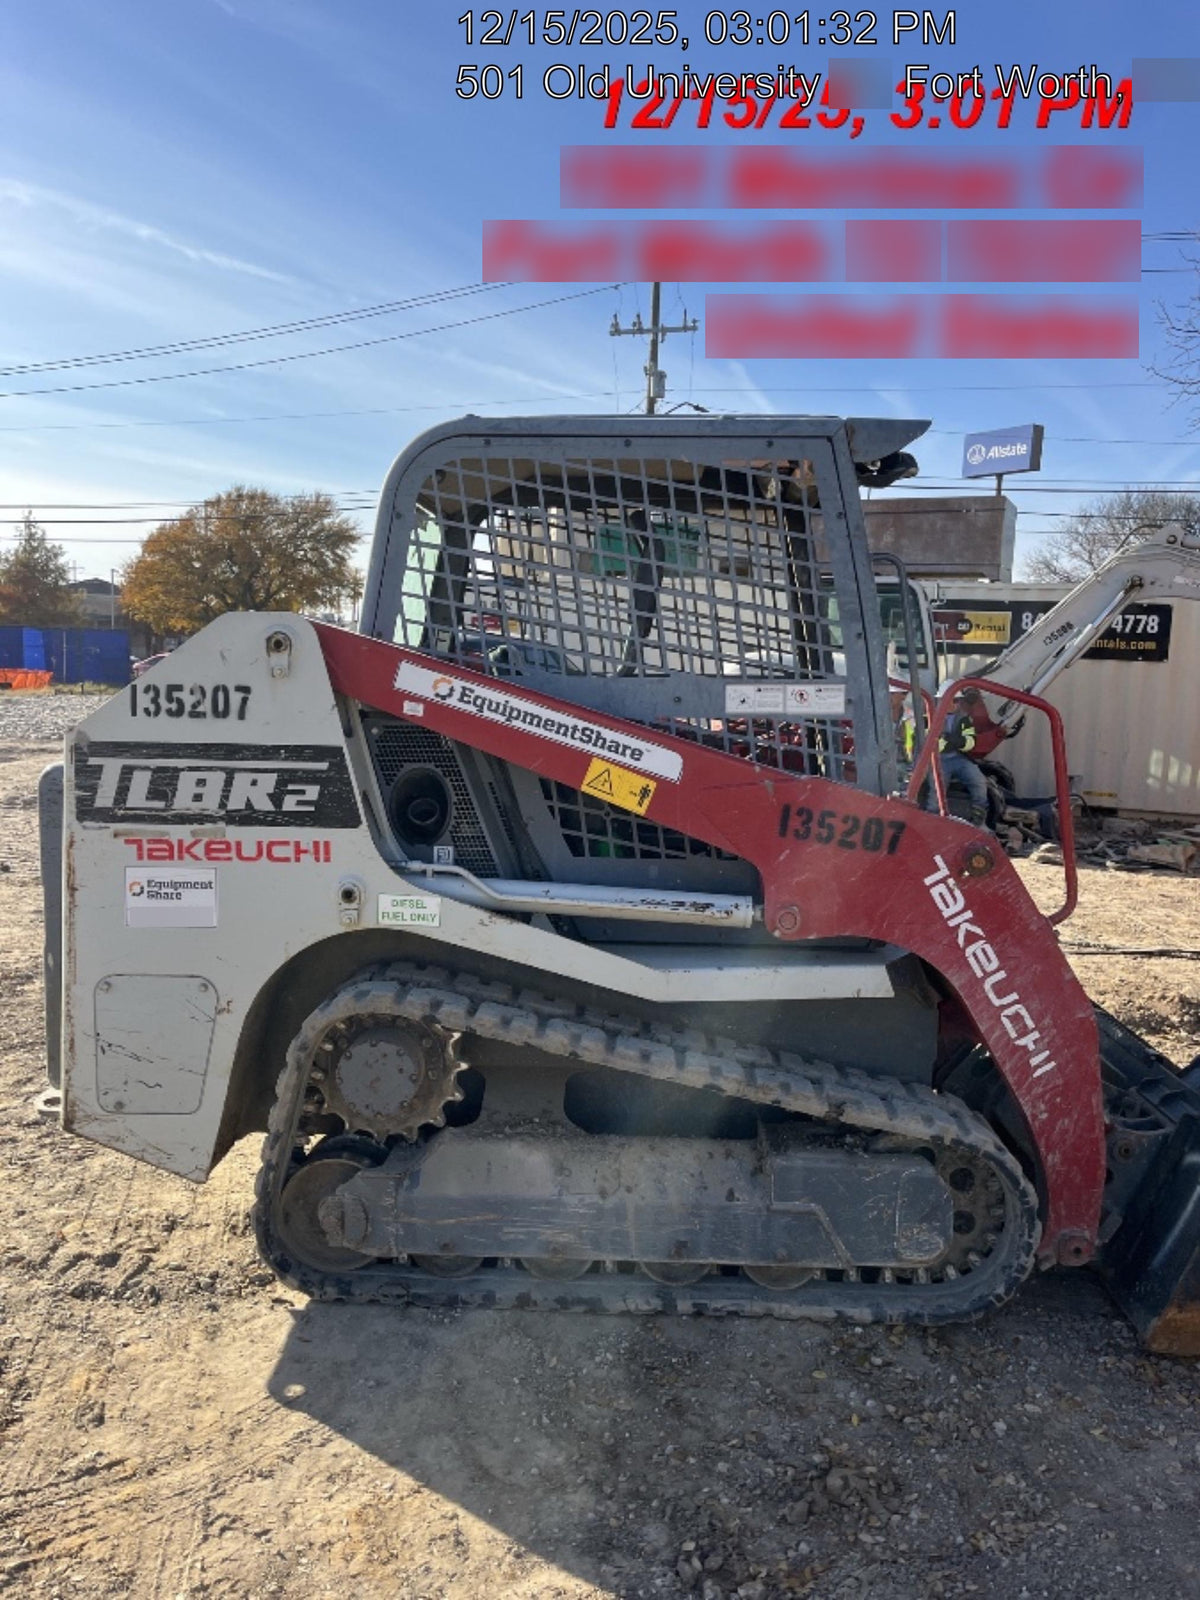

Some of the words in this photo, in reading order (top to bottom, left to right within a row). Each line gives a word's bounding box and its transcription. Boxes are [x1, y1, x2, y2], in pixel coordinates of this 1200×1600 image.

[986, 442, 1027, 460] Allstate
[1111, 614, 1160, 634] 4778
[130, 684, 251, 721] 135207
[458, 684, 645, 762] EquipmentShare
[779, 803, 906, 855] 135207
[146, 879, 214, 892] Equipment
[146, 890, 182, 901] Share
[391, 899, 428, 910] DIESEL
[381, 911, 408, 922] FUEL
[410, 912, 437, 923] ONLY
